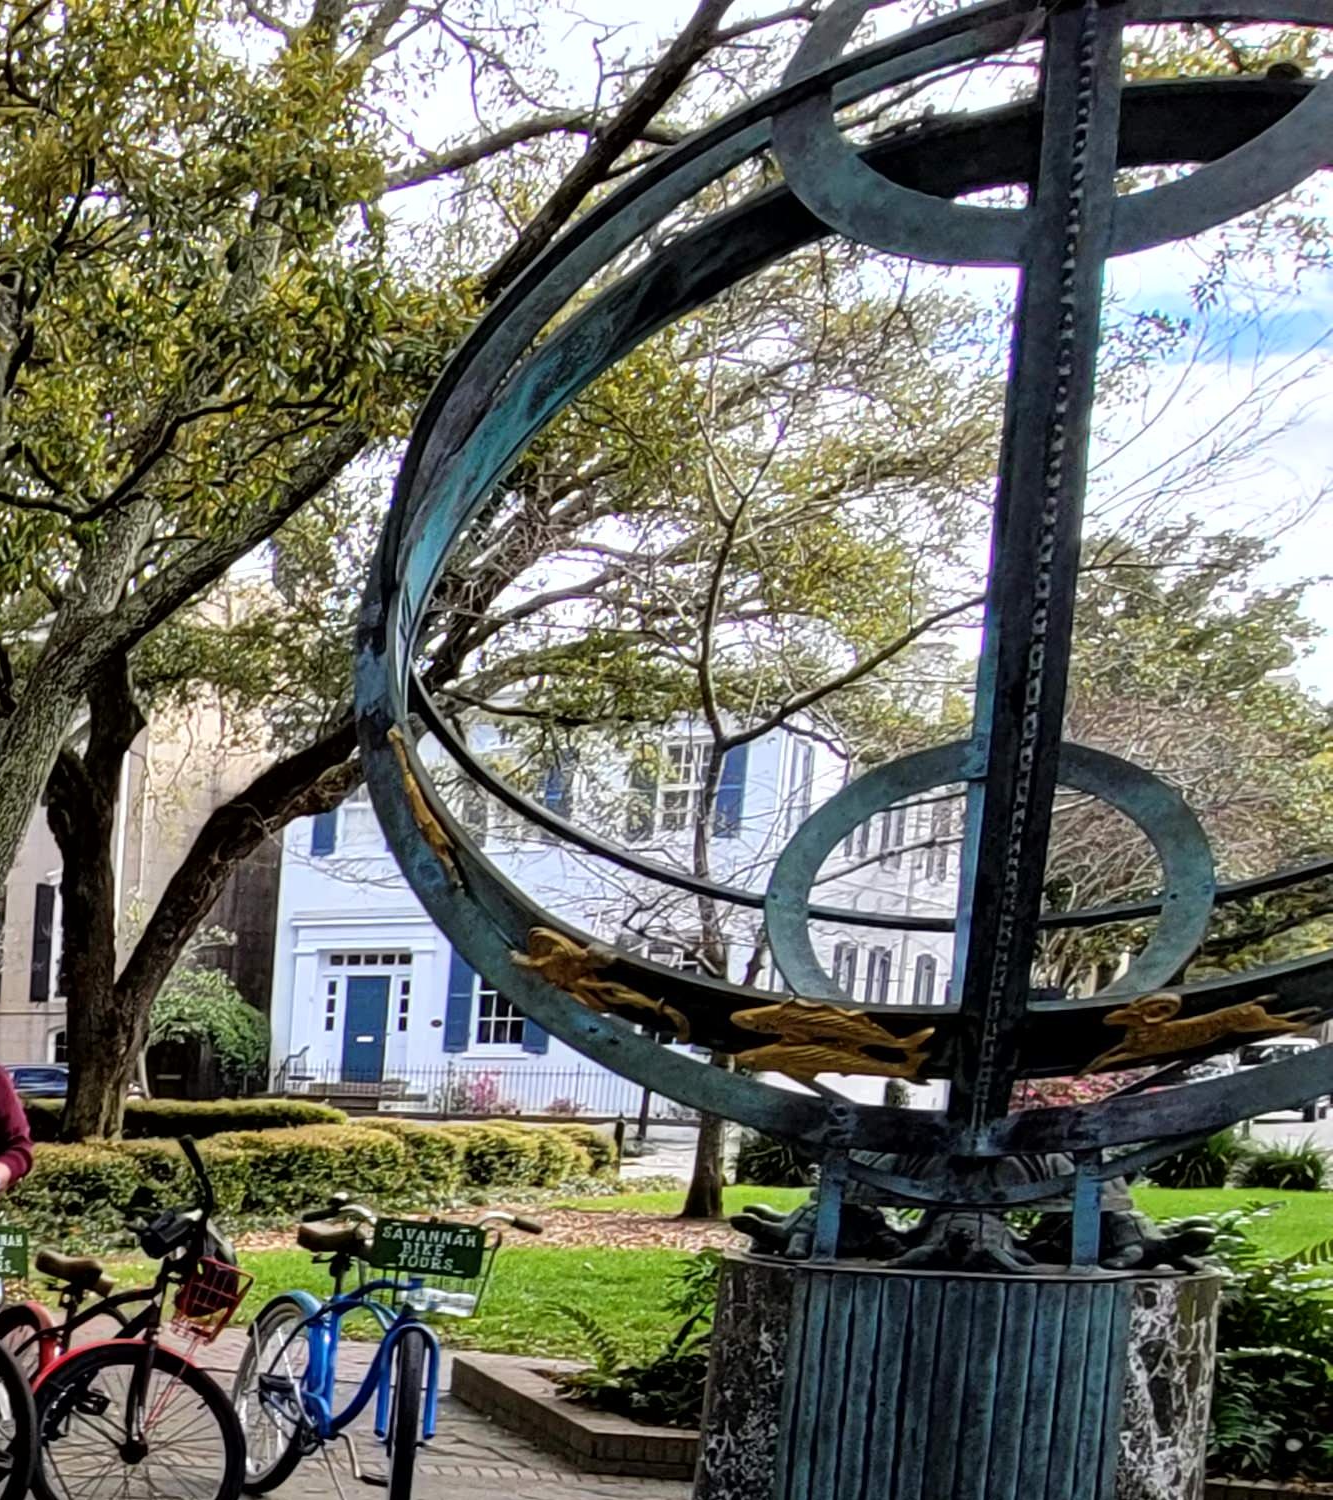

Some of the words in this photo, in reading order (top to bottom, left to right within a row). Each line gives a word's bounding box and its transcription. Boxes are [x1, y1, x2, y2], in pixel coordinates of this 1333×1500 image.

[382, 1226, 477, 1248] SAVANNAH
[402, 1241, 446, 1257] BIKE
[397, 1253, 454, 1271] TOURS
